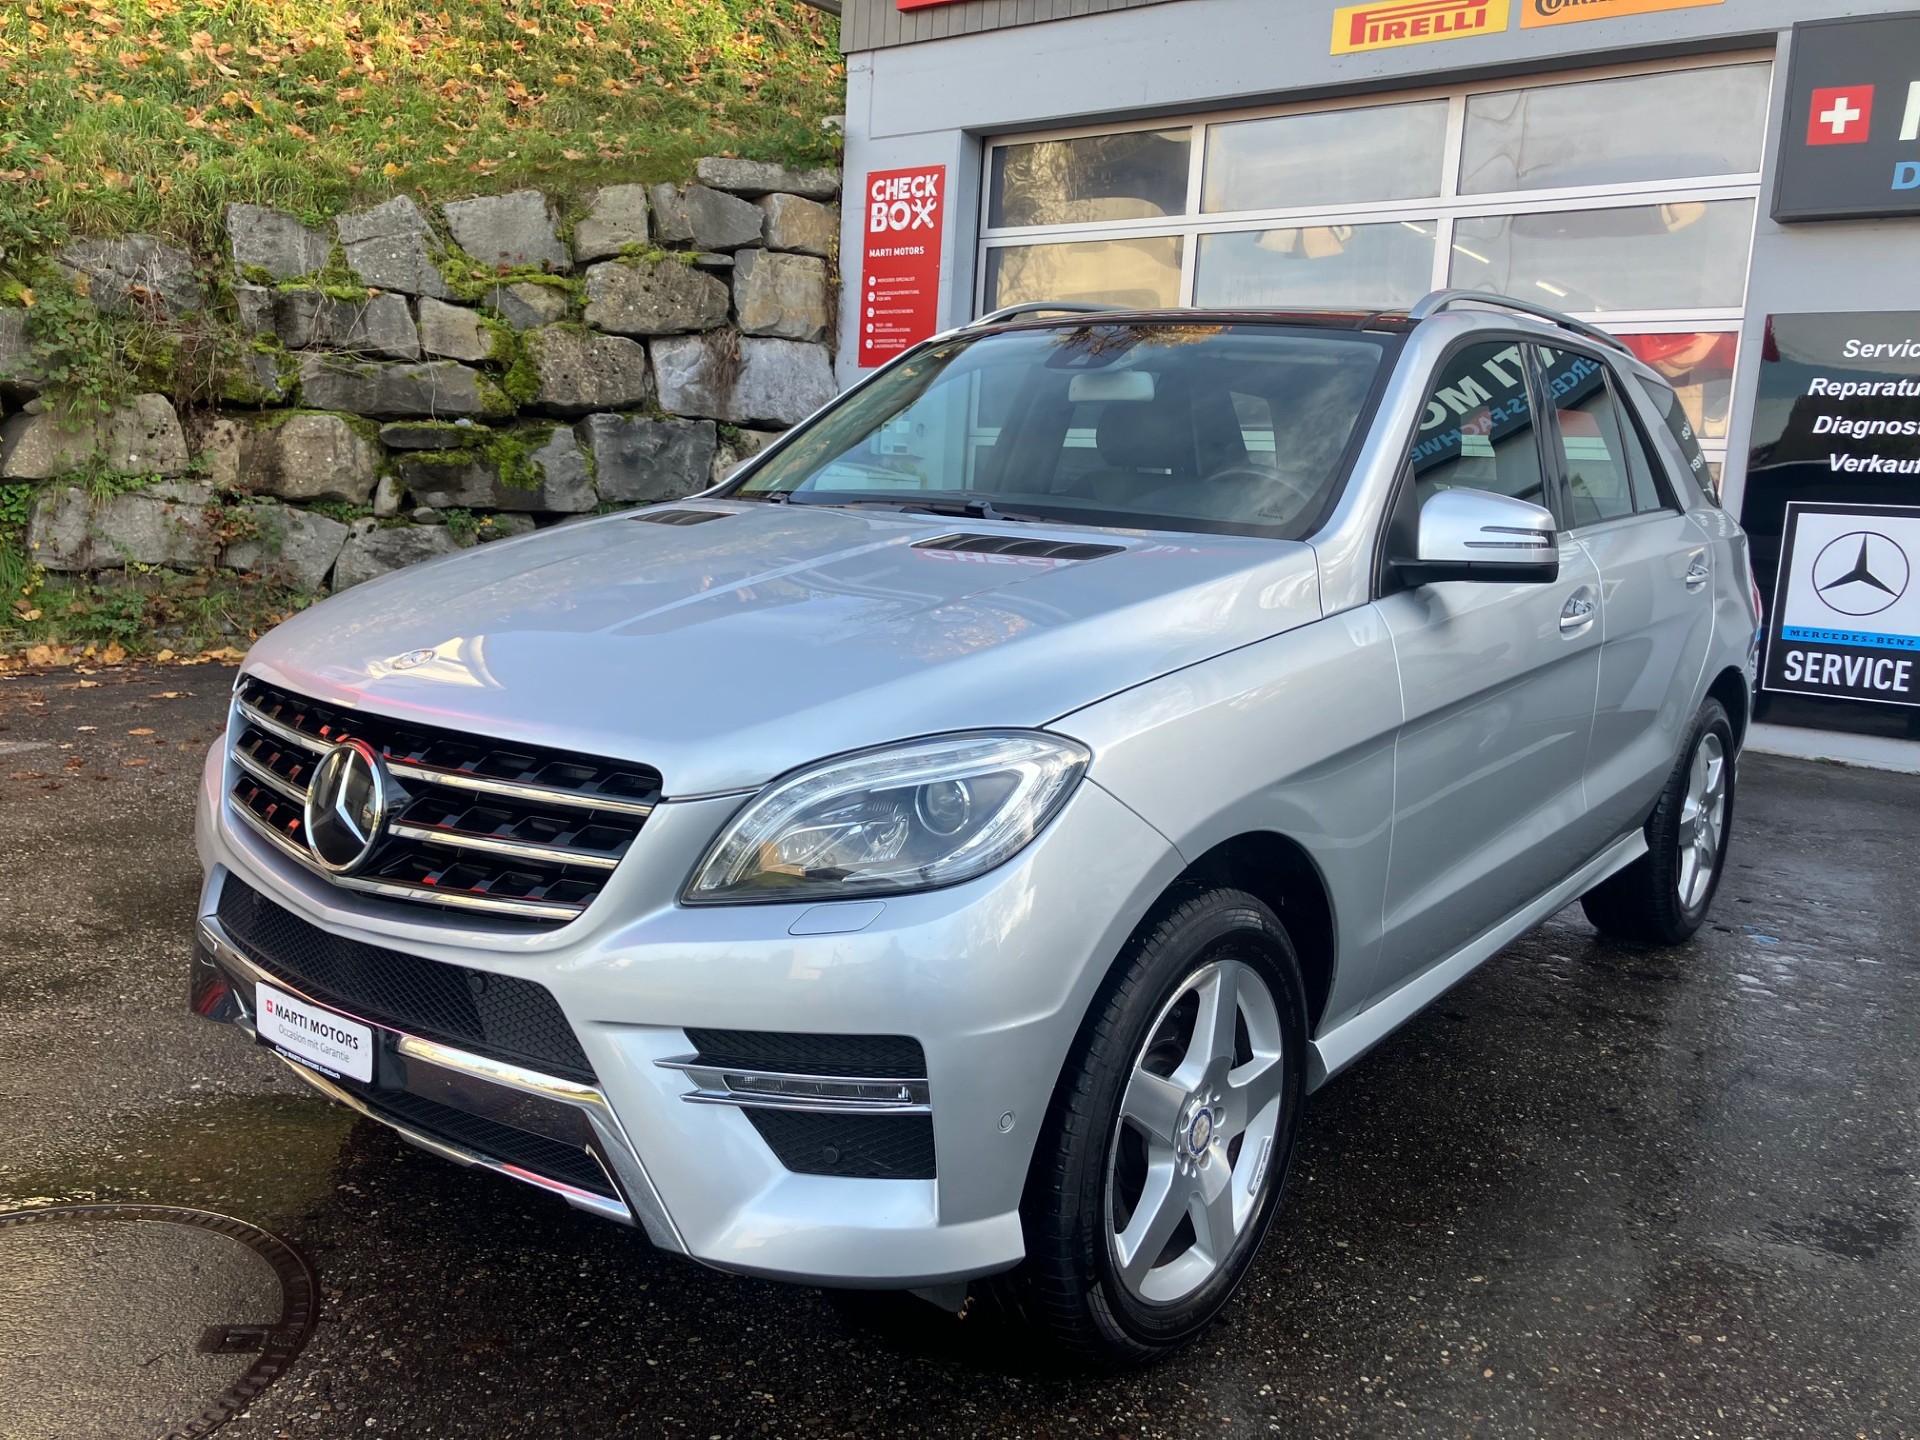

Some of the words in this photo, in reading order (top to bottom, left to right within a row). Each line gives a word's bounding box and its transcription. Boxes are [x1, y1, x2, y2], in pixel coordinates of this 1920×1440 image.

[1349, 0, 1488, 46] PIRELLI
[871, 173, 939, 202] CHECK
[869, 248, 892, 258] MARTI
[893, 246, 925, 256] MOTORS
[1789, 629, 1916, 647] MERCEDES-BENZ
[1783, 650, 1913, 692] SERVICE
[275, 1003, 308, 1030] MARTI
[310, 1019, 359, 1050] MOTORS
[278, 1023, 307, 1044] Occasion
[307, 1037, 319, 1050] mit
[320, 1043, 350, 1063] Garantie
